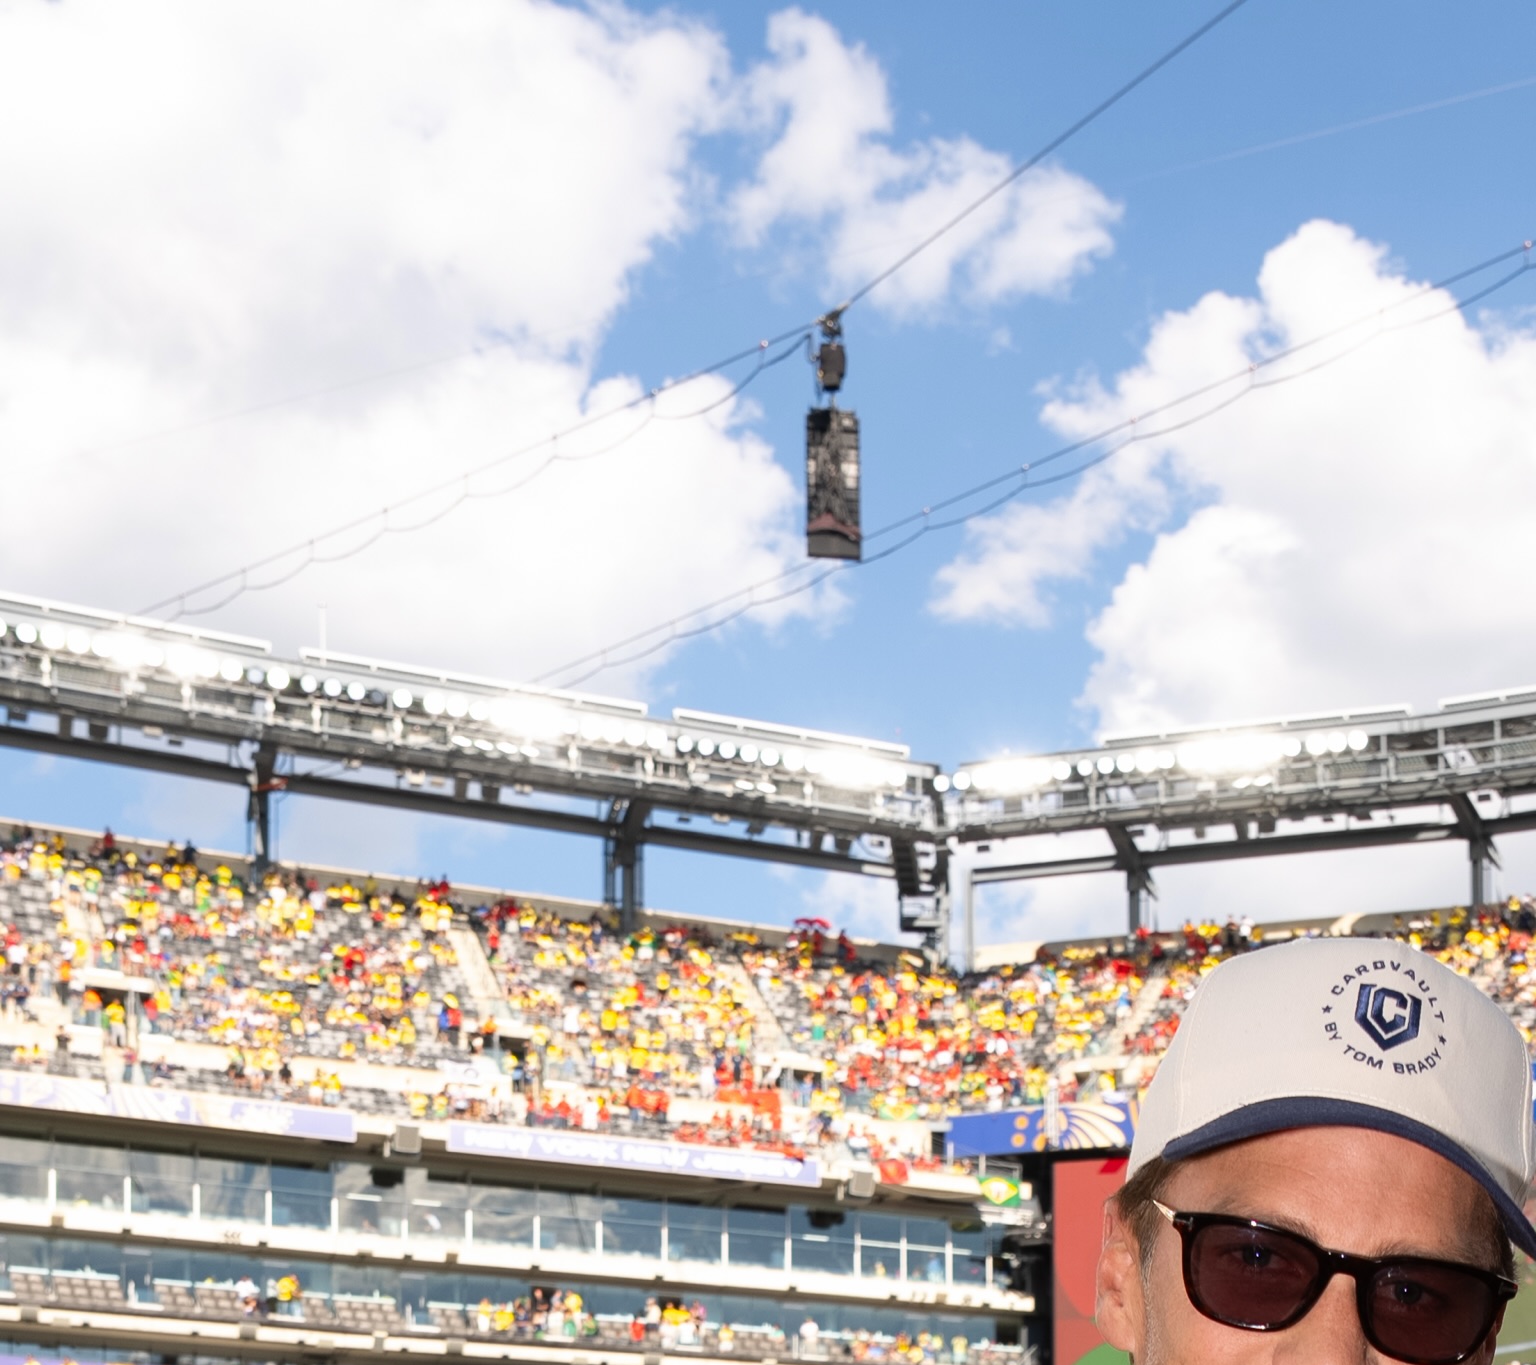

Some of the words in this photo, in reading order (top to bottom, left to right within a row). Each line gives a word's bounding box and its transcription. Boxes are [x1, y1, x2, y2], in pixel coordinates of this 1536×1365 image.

[1330, 960, 1445, 1023] CARDVAULT
[1324, 1022, 1342, 1041] BY
[1343, 1044, 1384, 1069] TOM
[1393, 1047, 1442, 1075] BRADY
